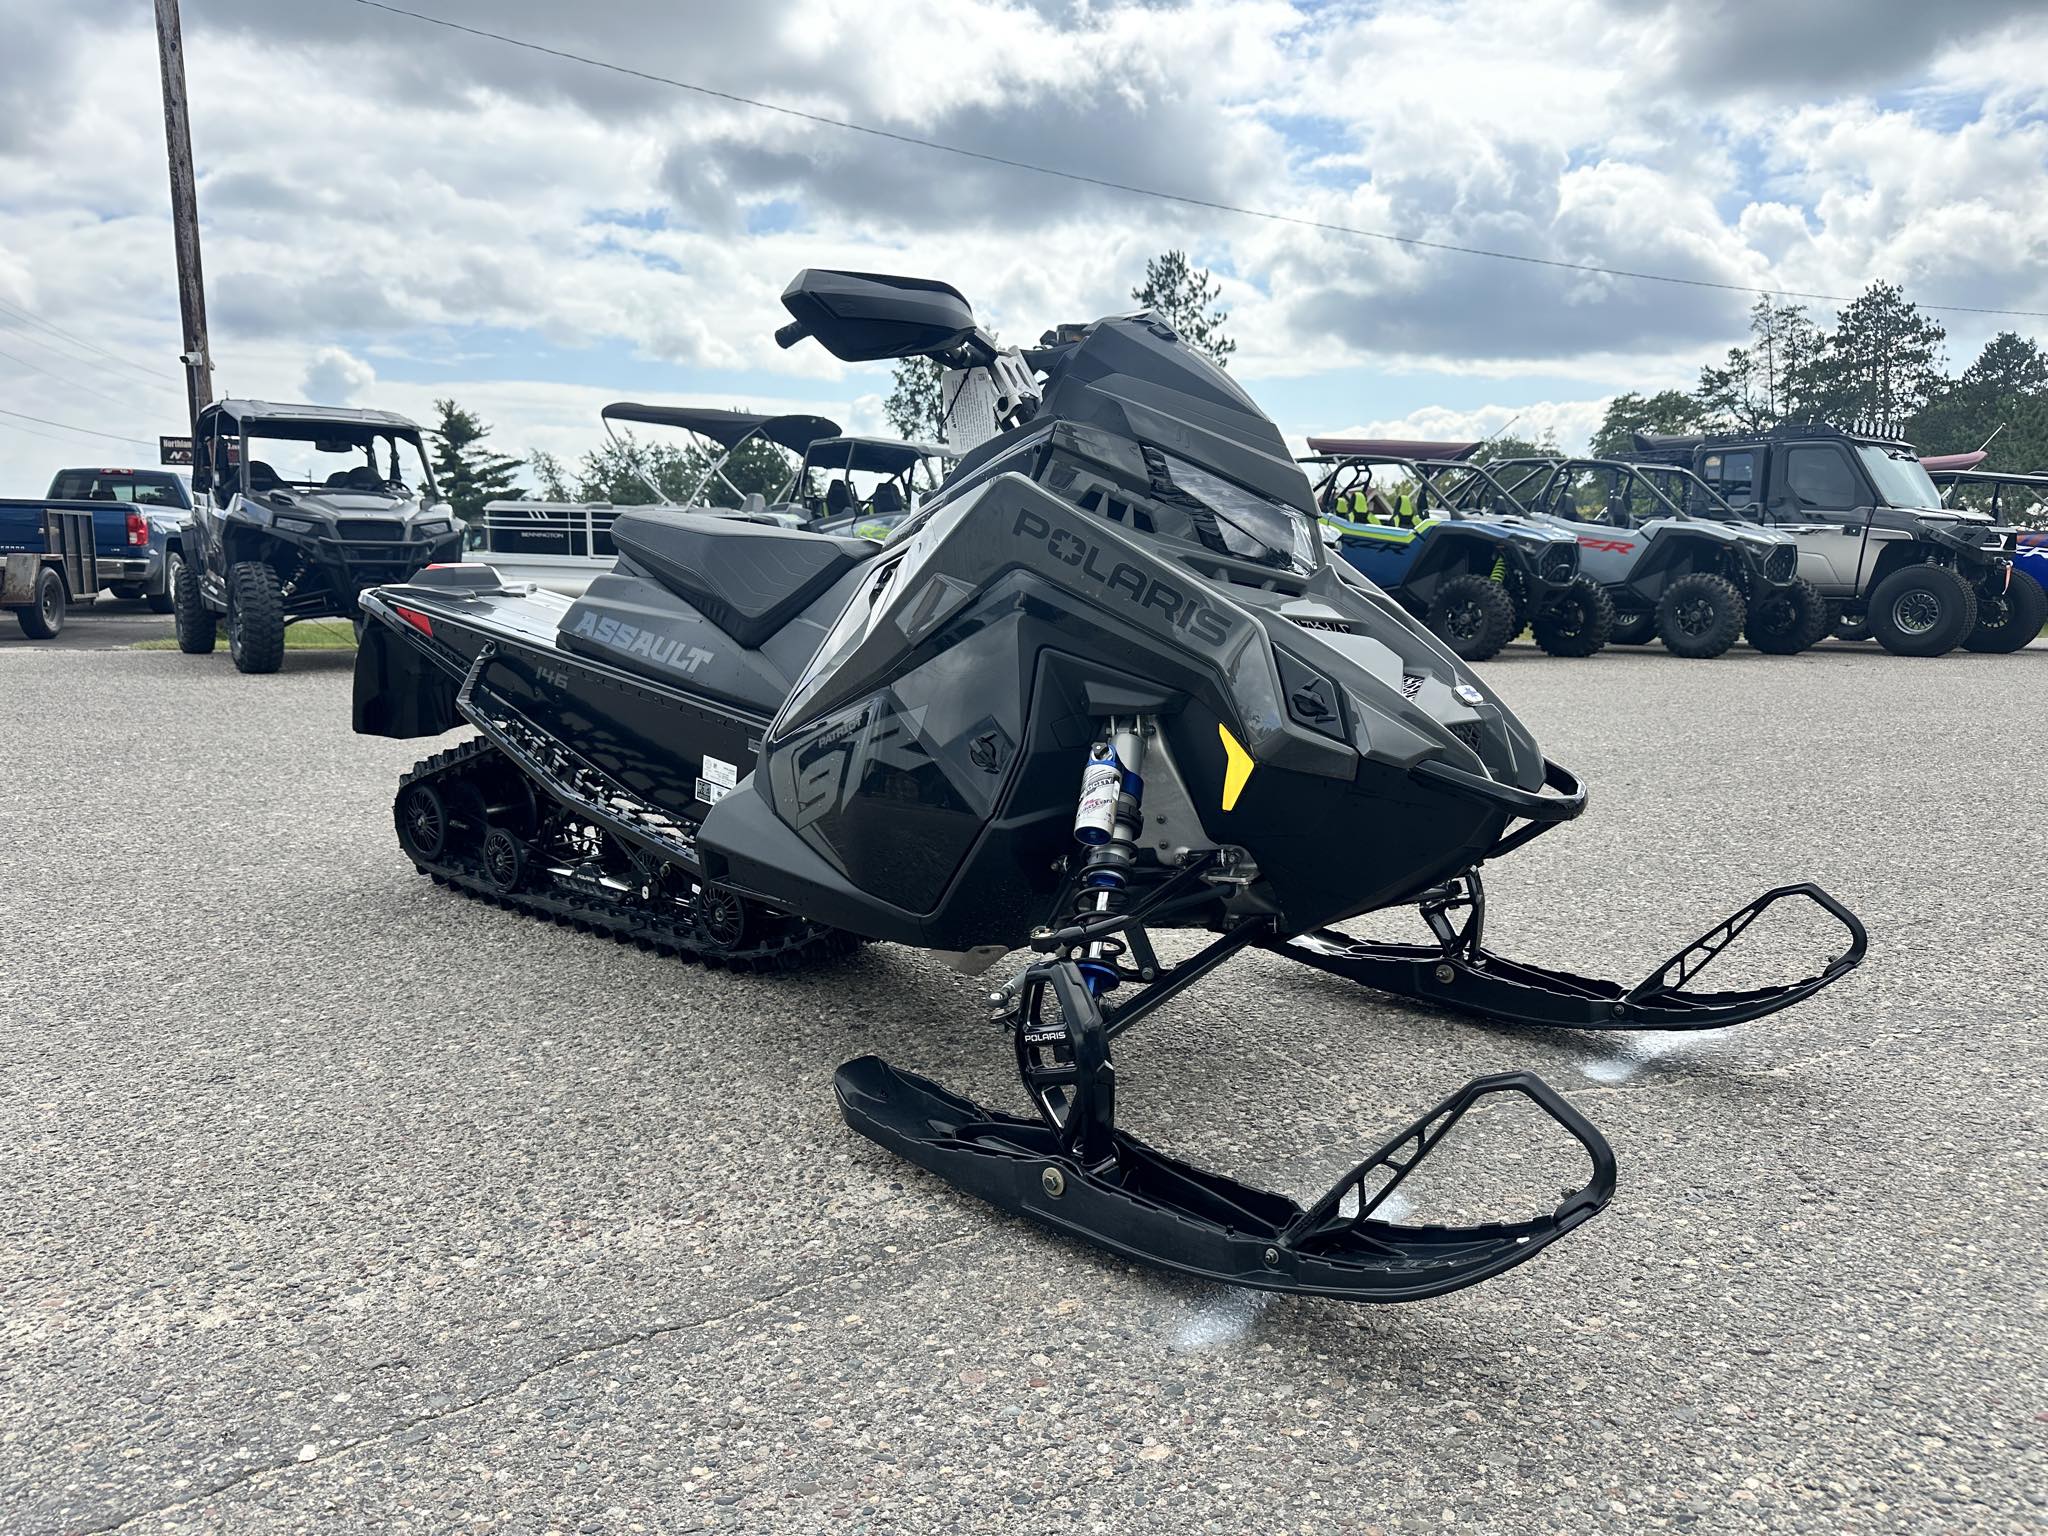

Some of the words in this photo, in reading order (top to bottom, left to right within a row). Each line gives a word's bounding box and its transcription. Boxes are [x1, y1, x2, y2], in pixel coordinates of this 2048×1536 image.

[163, 439, 192, 449] Northlan
[1576, 537, 1635, 555] ZR
[1012, 508, 1233, 648] POLARIS
[573, 610, 715, 675] ASSAULT
[535, 665, 569, 690] 146
[817, 713, 863, 748] PATRIOT
[1024, 1031, 1066, 1042] POLARIS
